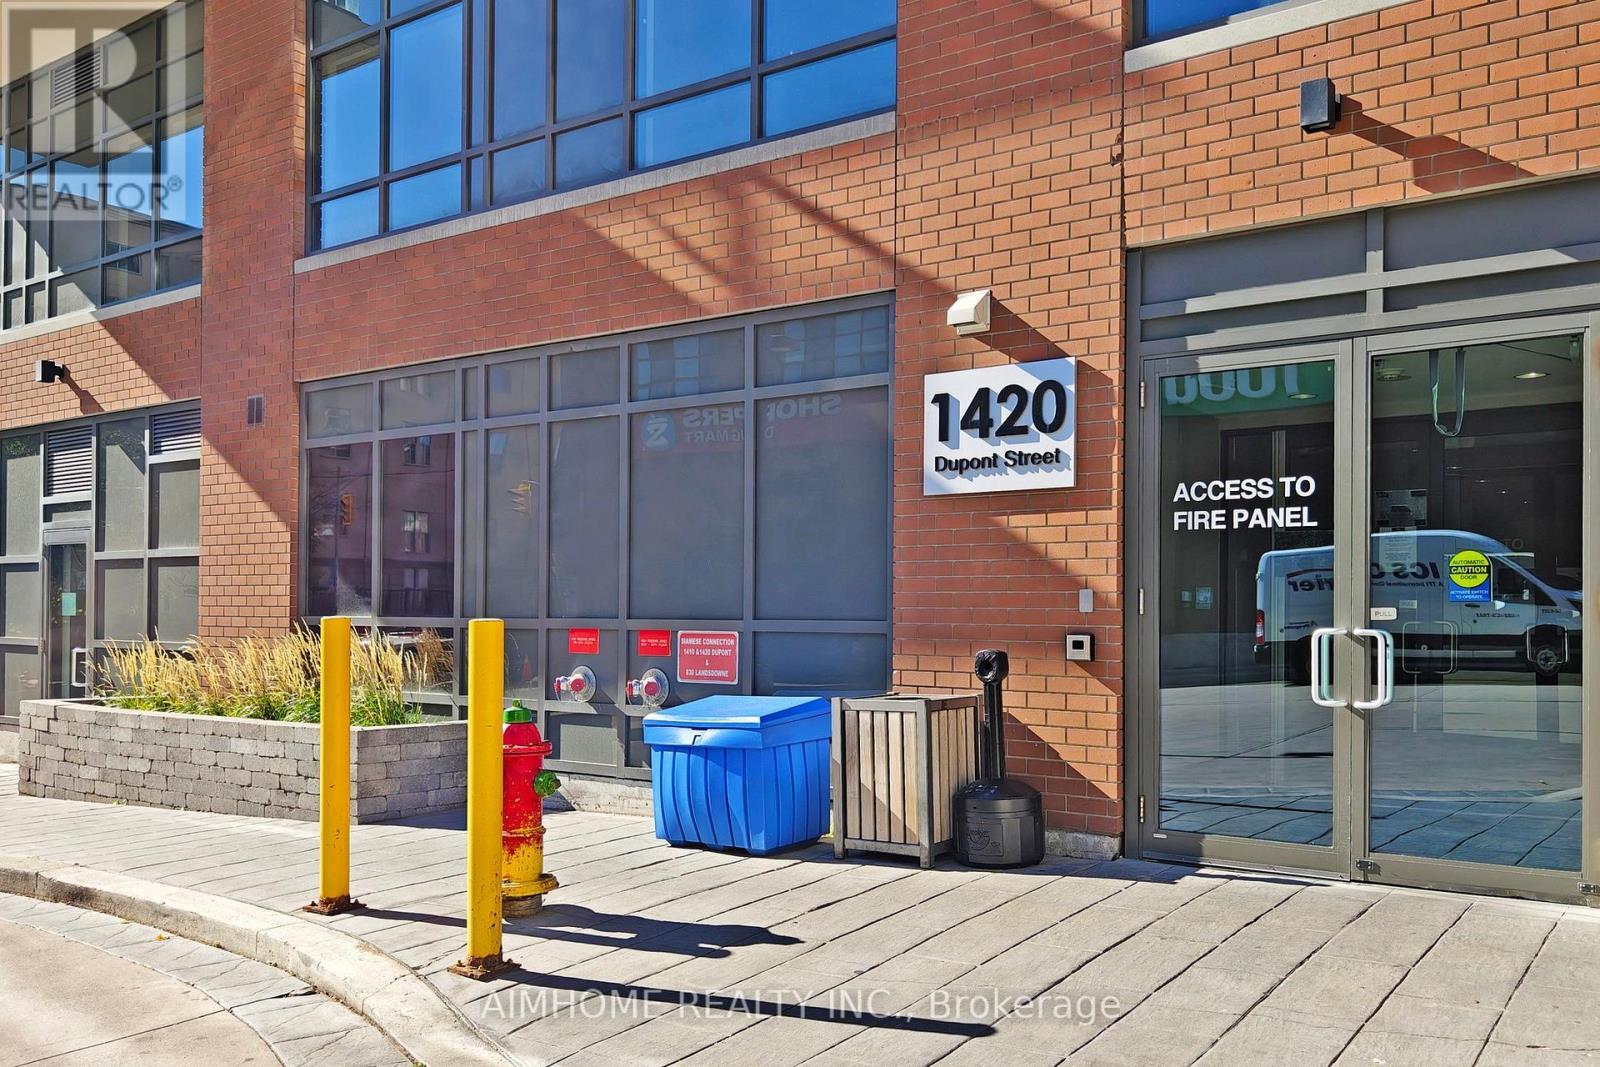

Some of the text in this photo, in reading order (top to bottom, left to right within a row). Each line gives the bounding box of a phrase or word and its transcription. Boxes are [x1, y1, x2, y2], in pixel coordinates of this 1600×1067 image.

[931, 379, 1067, 442] 1420
[934, 447, 1061, 475] Dupont Street
[1172, 475, 1316, 503] ACCESS TO
[1173, 506, 1318, 531] FIRE PANEL
[1451, 566, 1487, 574] CAUTION
[681, 637, 735, 646] SIAMESE CONNECTION
